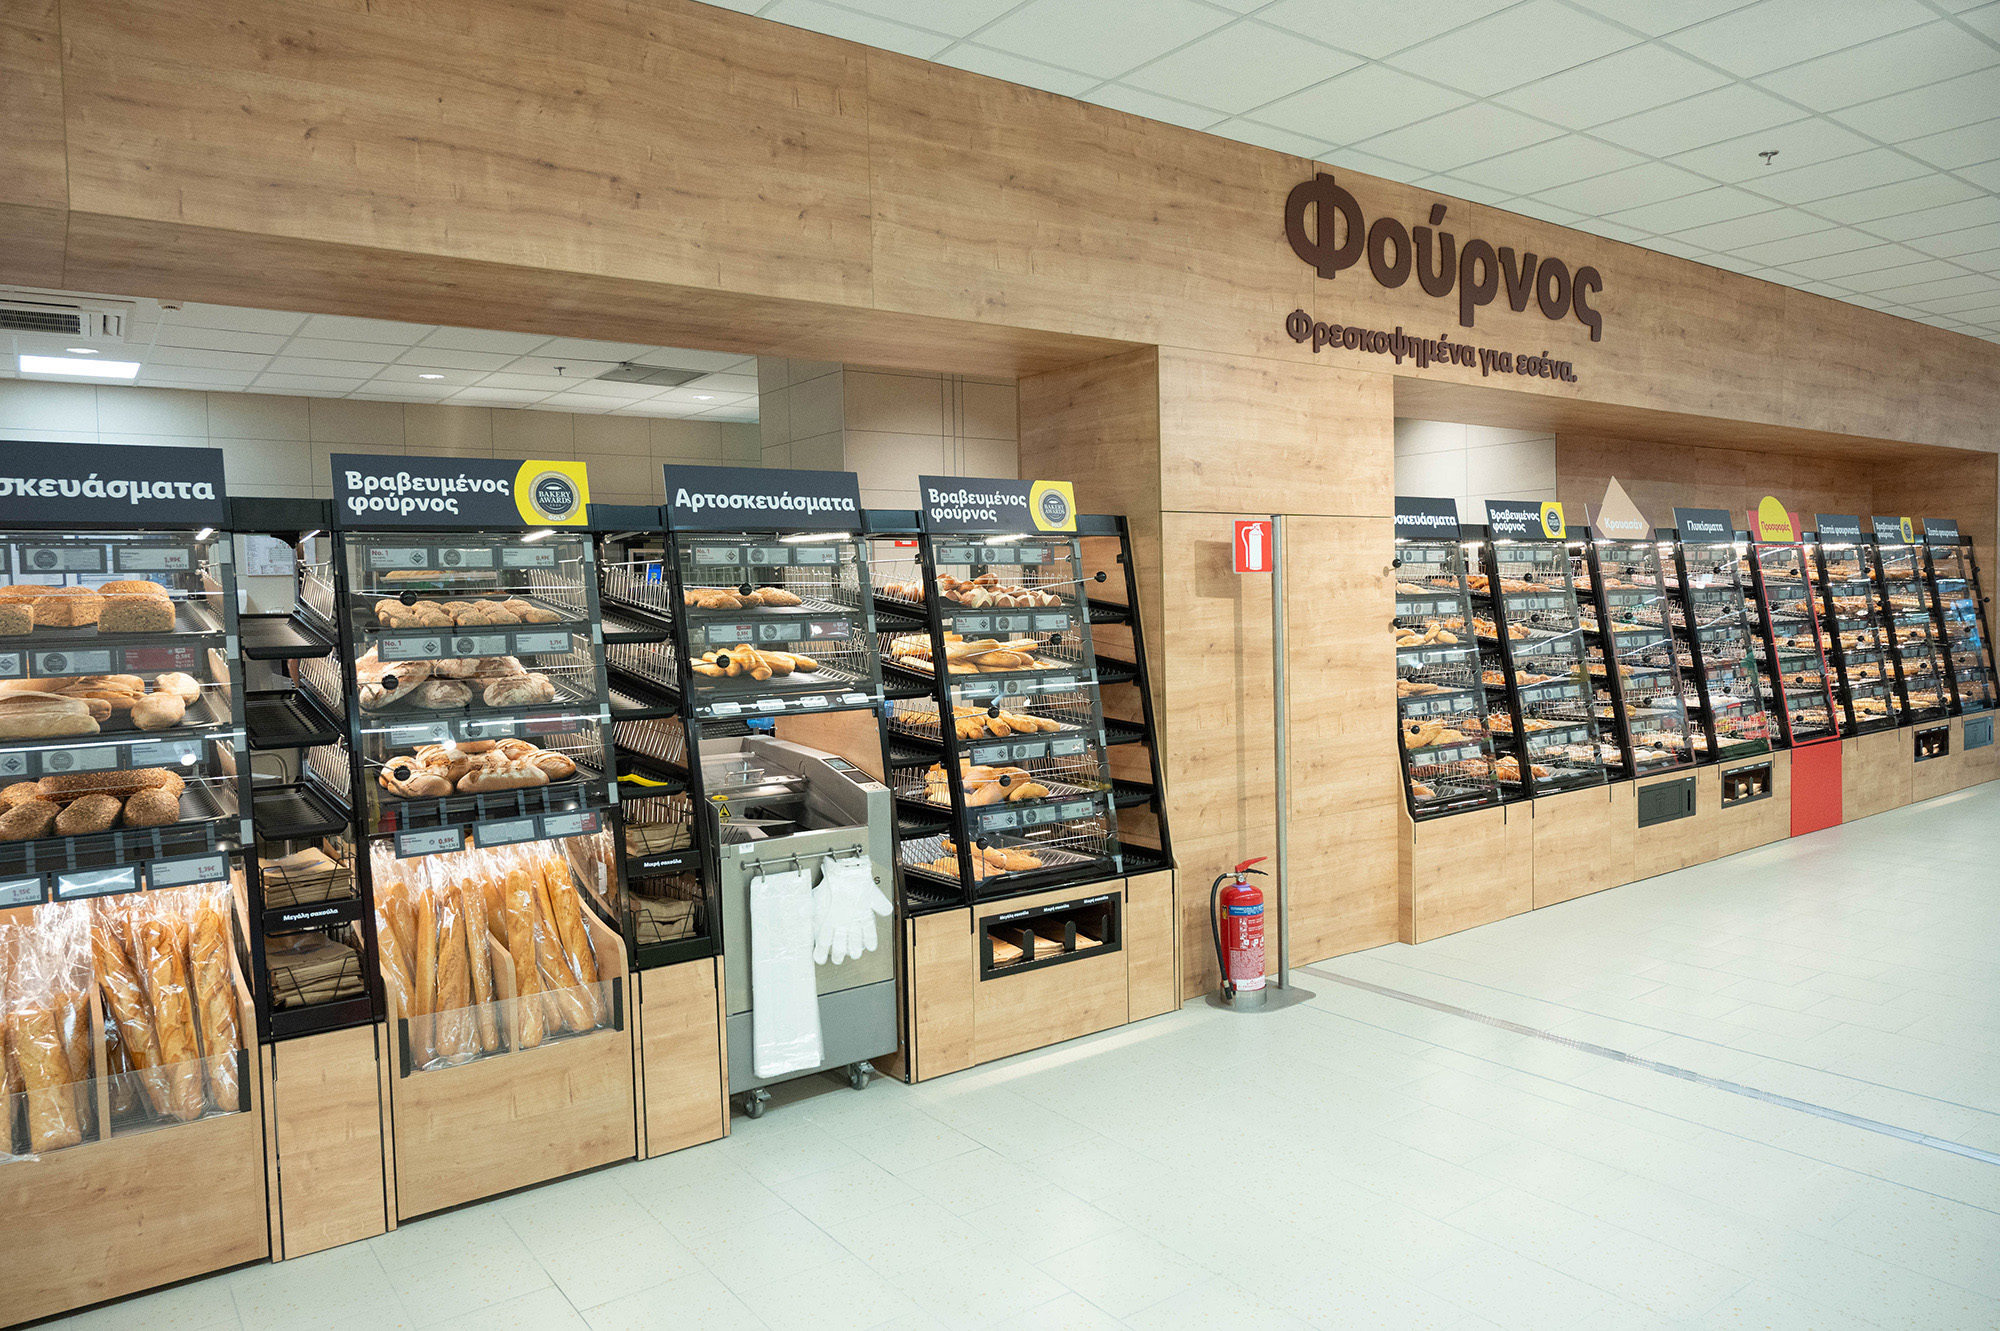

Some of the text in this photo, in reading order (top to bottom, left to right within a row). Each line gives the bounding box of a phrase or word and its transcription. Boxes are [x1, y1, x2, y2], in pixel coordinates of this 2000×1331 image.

[1285, 172, 1603, 342] Φούρνος
[1286, 309, 1578, 382] Φρεσκοψημένα για εσένα.
[345, 470, 509, 496] Βραβευμένος
[348, 492, 458, 515] φούρνος
[675, 488, 856, 514] Αρτοσκευάσματα
[928, 488, 1026, 508] Βραβευμένος
[930, 506, 998, 523] φούρνος
[1490, 509, 1540, 522] Βραβευμένος
[1492, 522, 1526, 533] φούρνος
[1604, 517, 1642, 531] Κρουασάν
[1761, 521, 1791, 534] Προσφορές
[283, 908, 338, 921] Μεγάλη σακούλα
